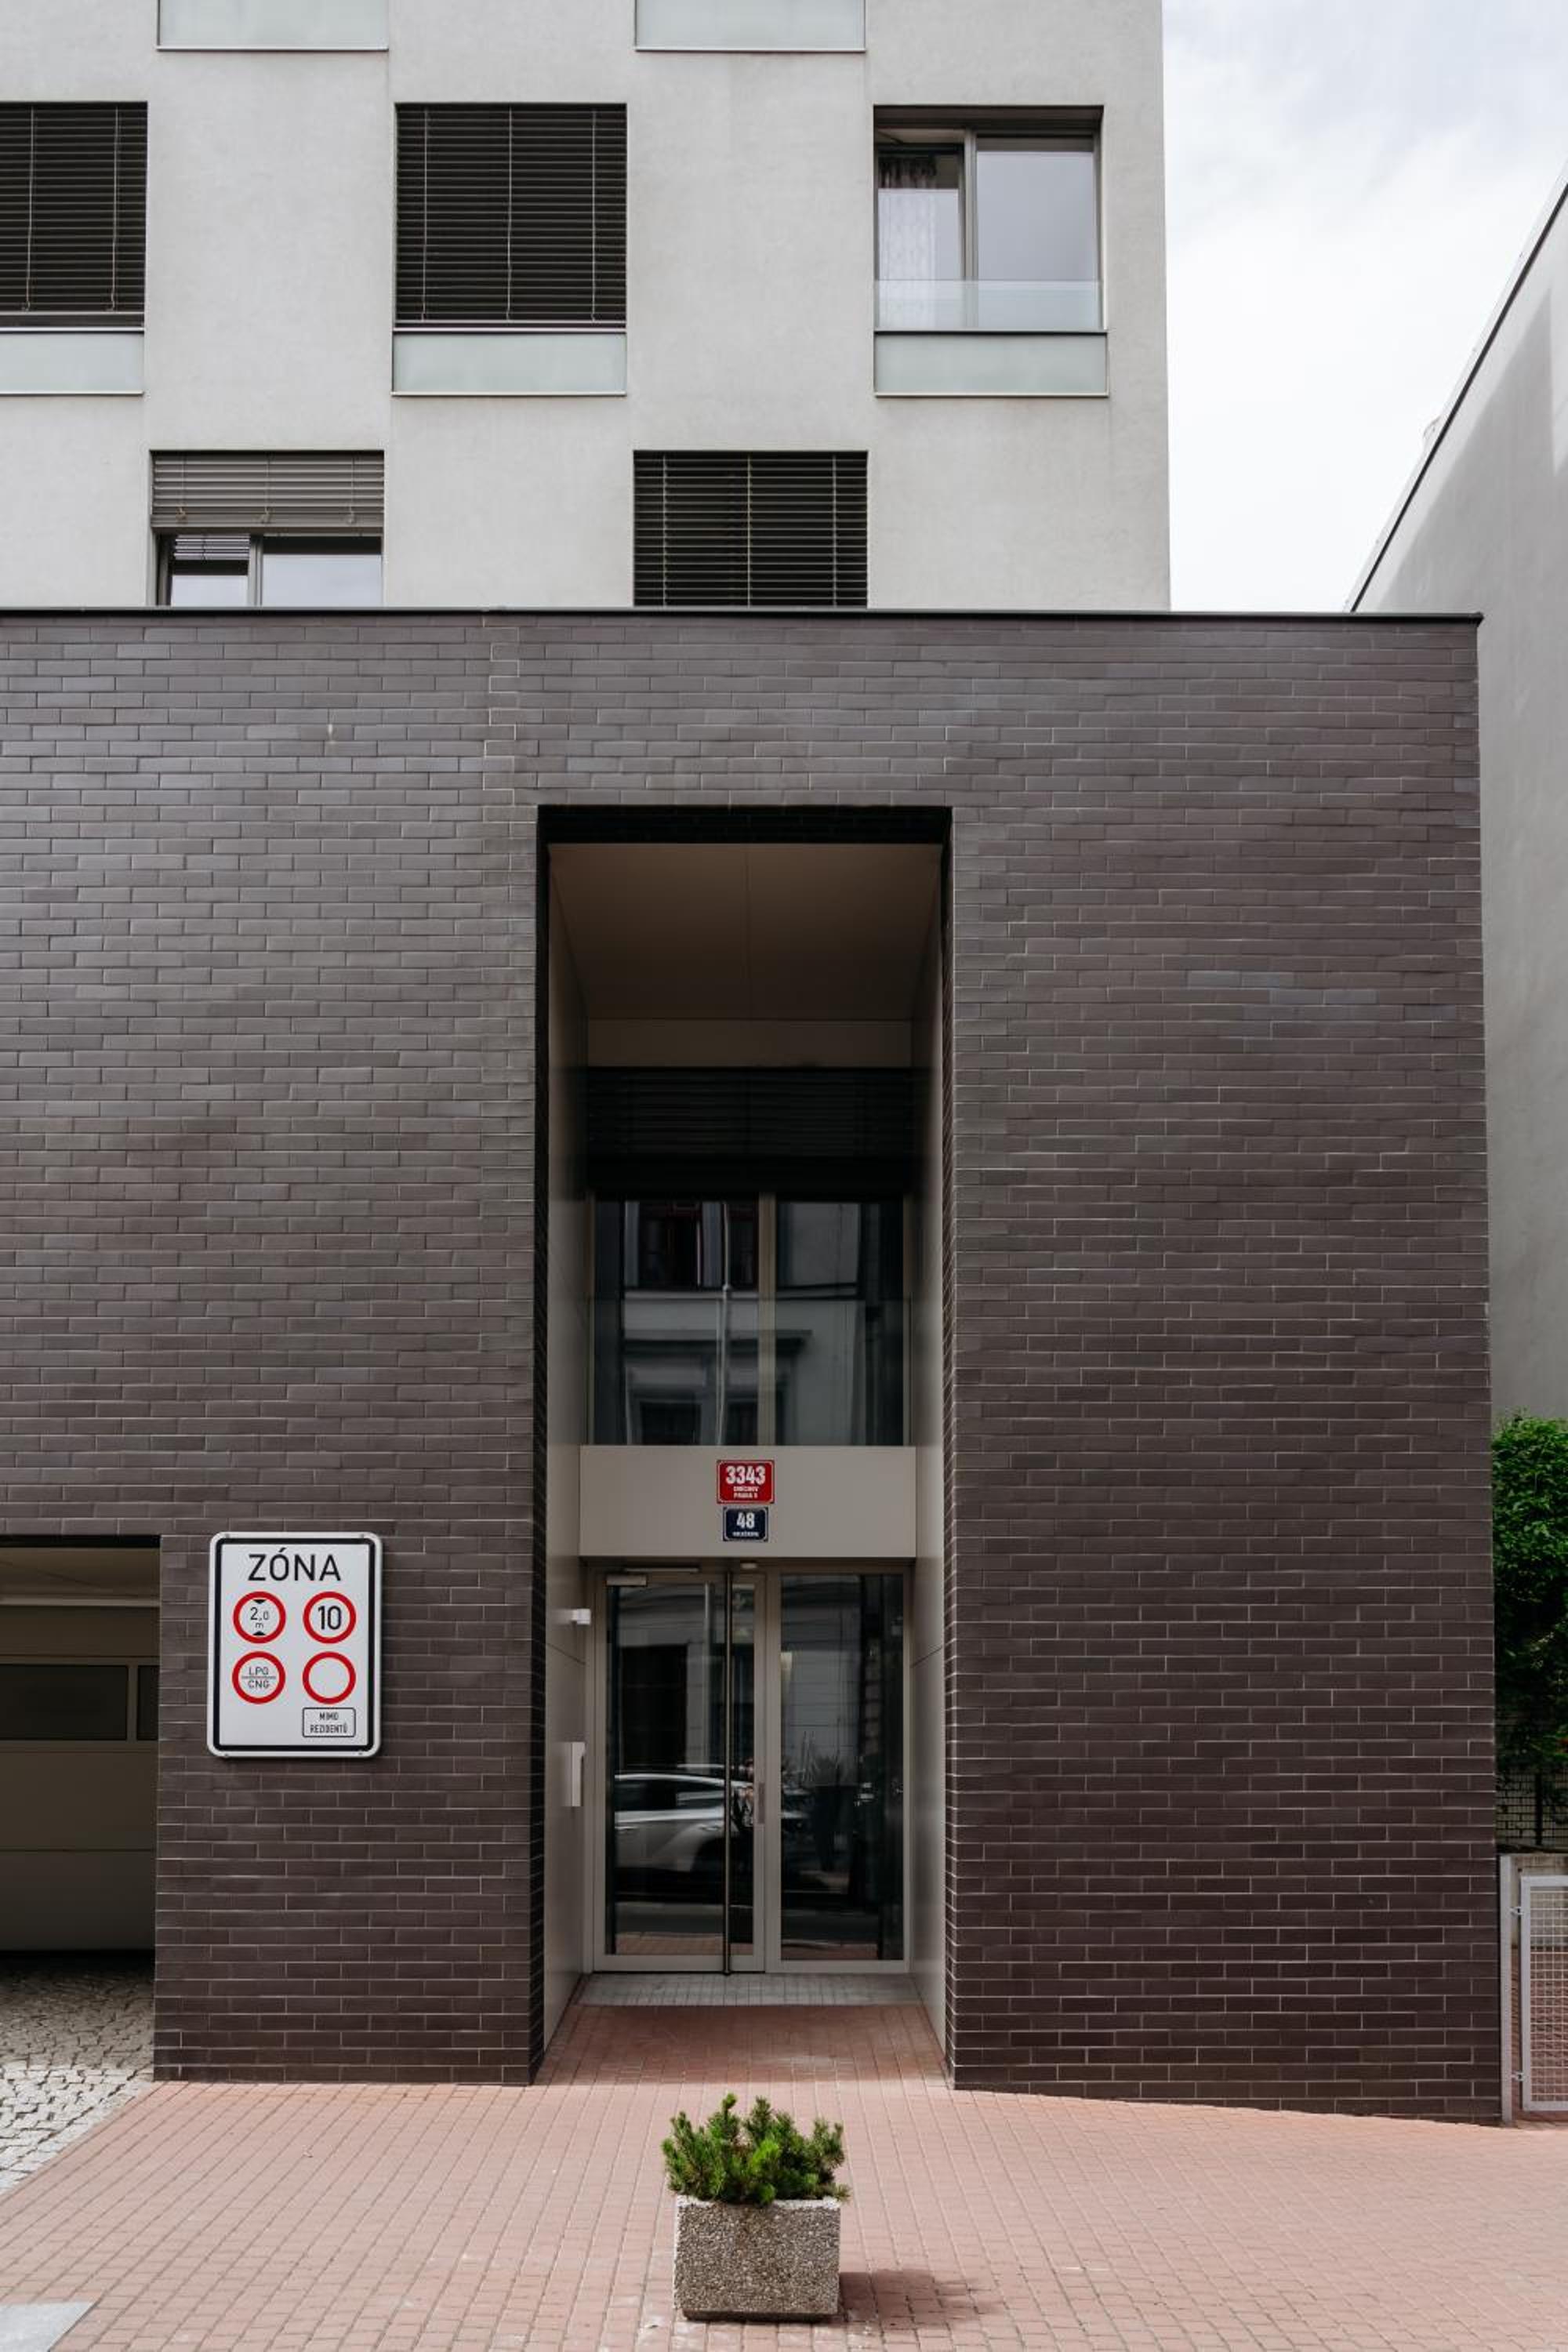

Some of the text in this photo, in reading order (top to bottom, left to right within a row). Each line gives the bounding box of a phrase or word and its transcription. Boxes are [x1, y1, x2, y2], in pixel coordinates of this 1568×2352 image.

[726, 1465, 766, 1485] 3343
[736, 1512, 755, 1529] 48
[247, 1547, 342, 1581] ZÓNA
[249, 1607, 270, 1621] 2,0
[318, 1605, 342, 1630] 10
[249, 1666, 269, 1675] LPG
[247, 1679, 270, 1689] CNG
